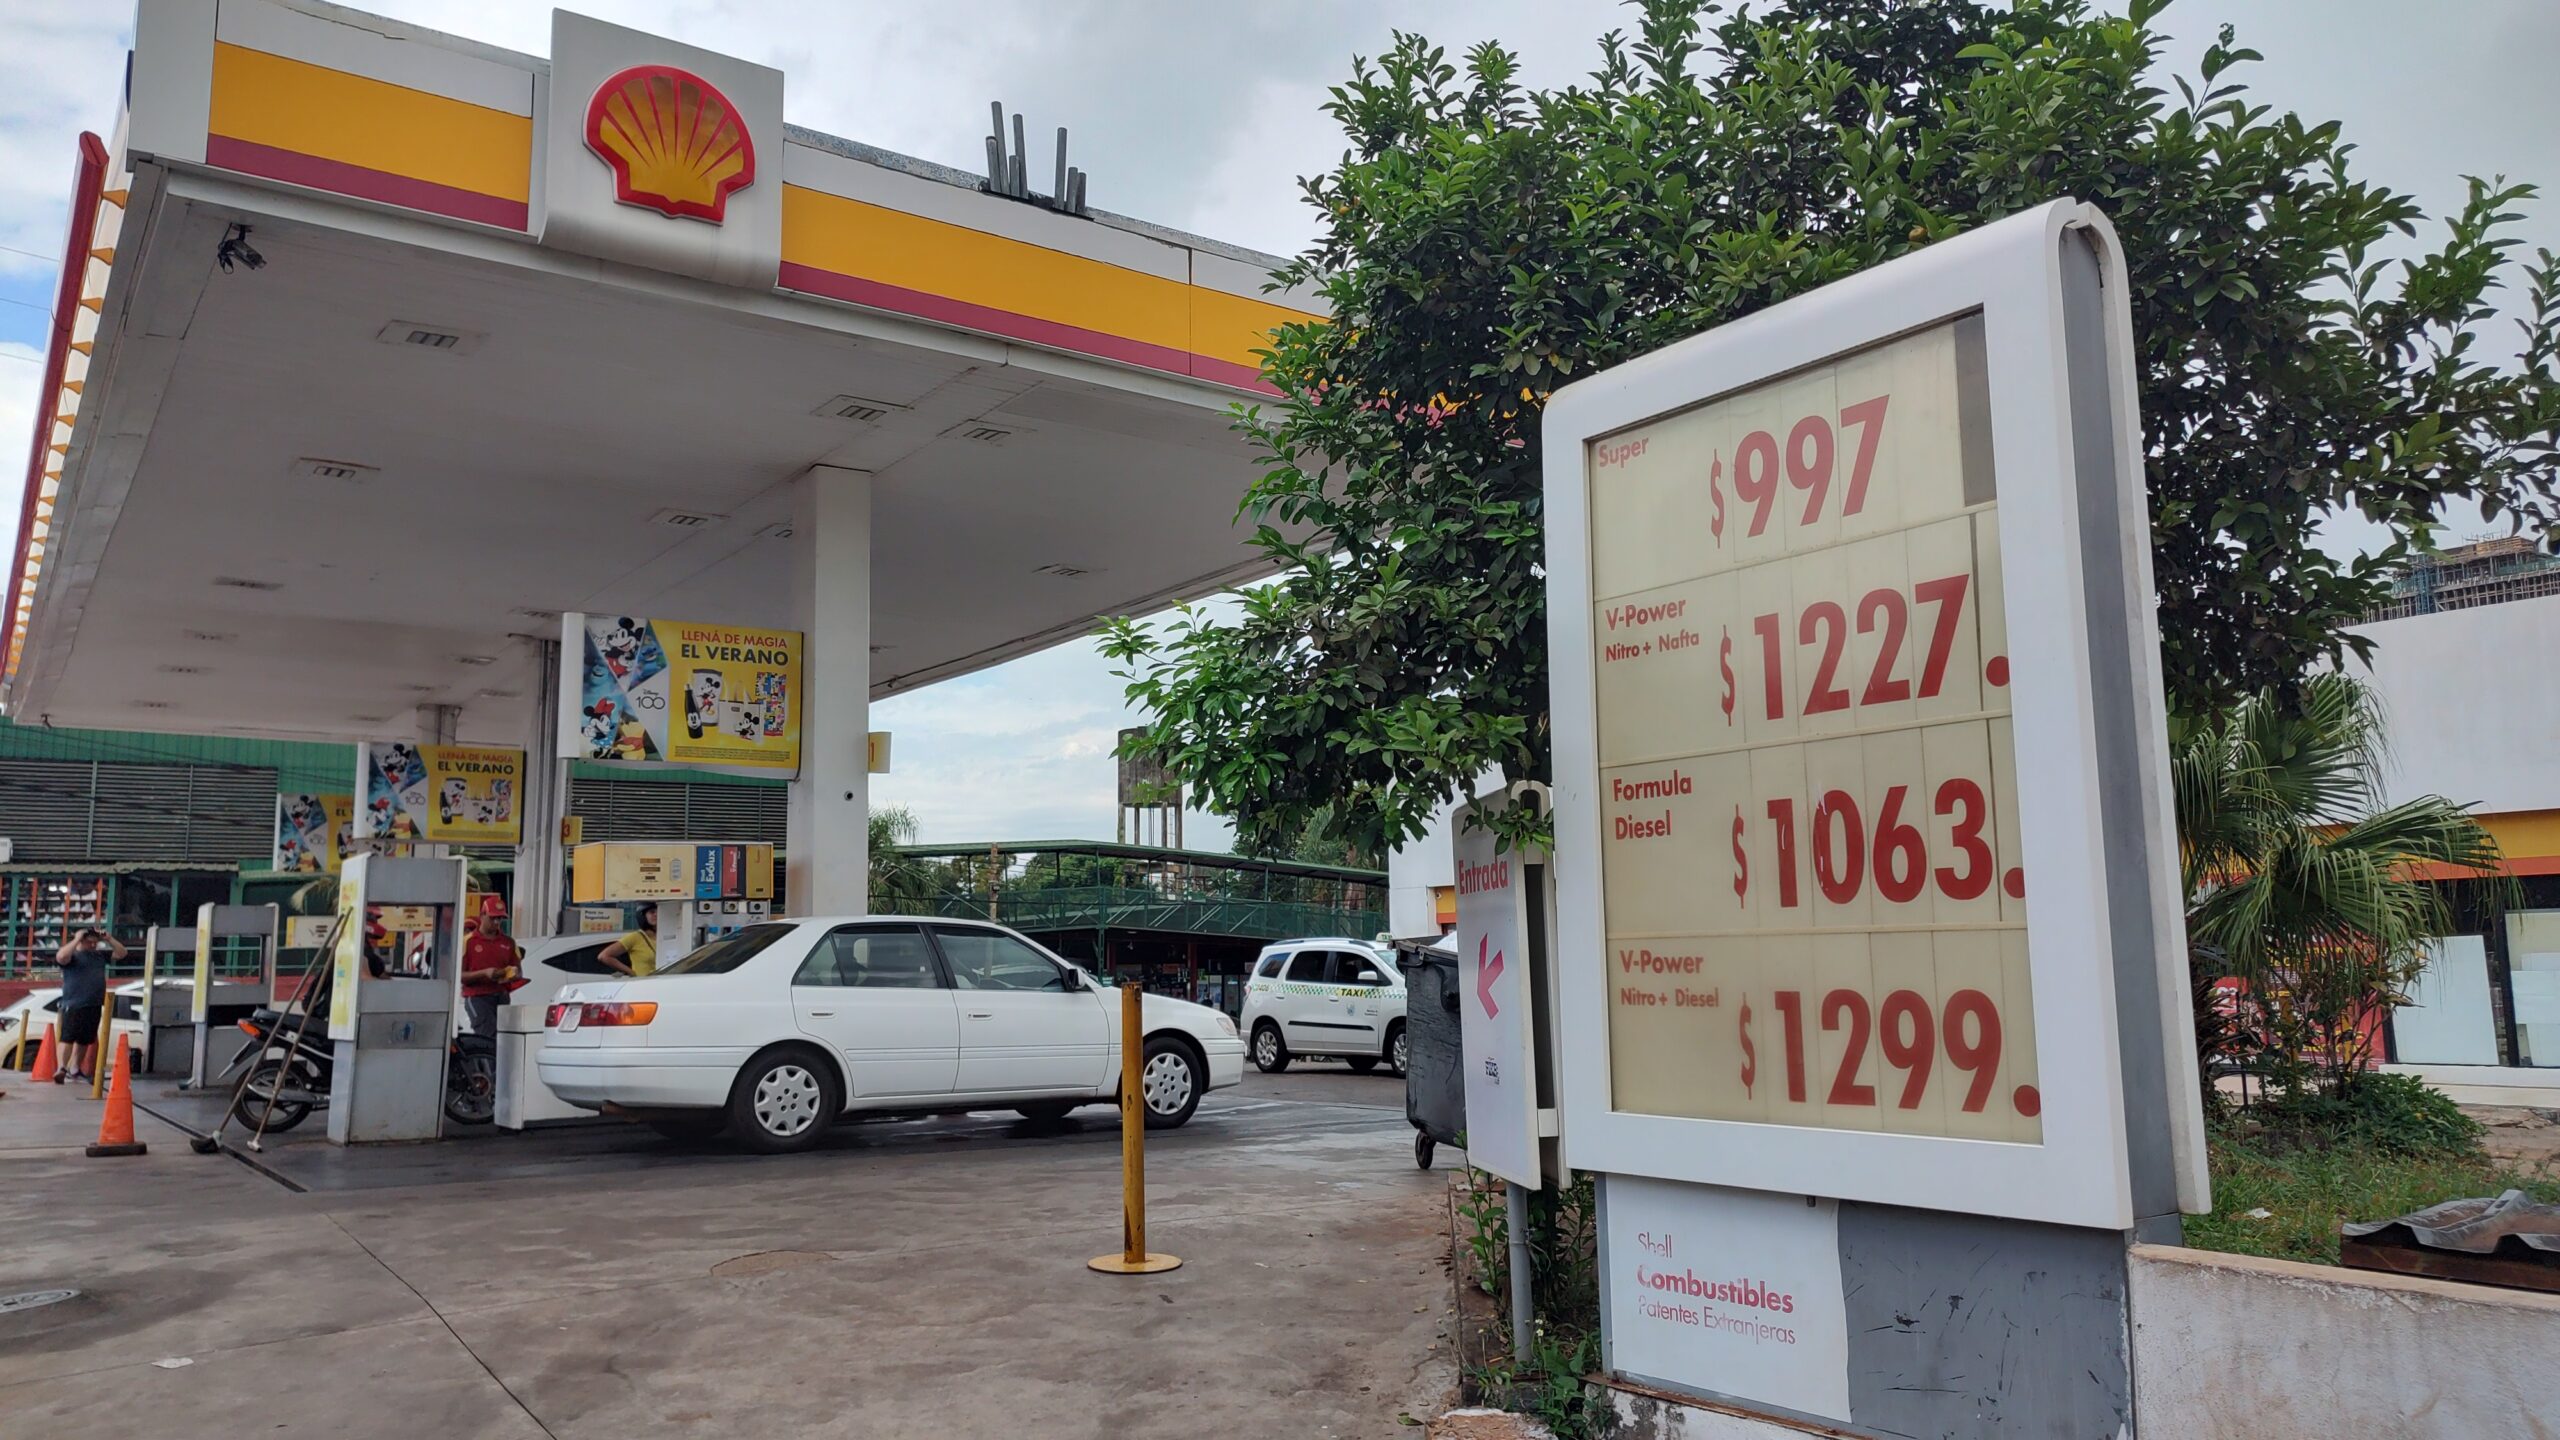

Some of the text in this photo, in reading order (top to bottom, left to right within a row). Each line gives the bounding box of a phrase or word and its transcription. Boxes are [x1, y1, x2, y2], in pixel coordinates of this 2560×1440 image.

[1599, 437, 1649, 468] Super
[1710, 394, 1890, 548] $997
[1605, 599, 1686, 631] V-Power
[681, 630, 787, 648] LLENÁ DE MAGIA
[1658, 629, 1700, 652] Nafta
[681, 643, 789, 666] EL VERANO
[438, 761, 515, 775] EL VERANO
[1613, 770, 1692, 801] Formula
[1615, 810, 1671, 840] Diesel
[1459, 853, 1509, 895] Entrada
[1620, 950, 1703, 975] V-Power
[1341, 988, 1364, 998] TAXI
[1675, 987, 1719, 1008] Diesel
[1638, 1232, 1672, 1258] Shell
[1637, 1263, 1794, 1314] Combustibles
[1704, 1305, 1796, 1345] Extranjeras
